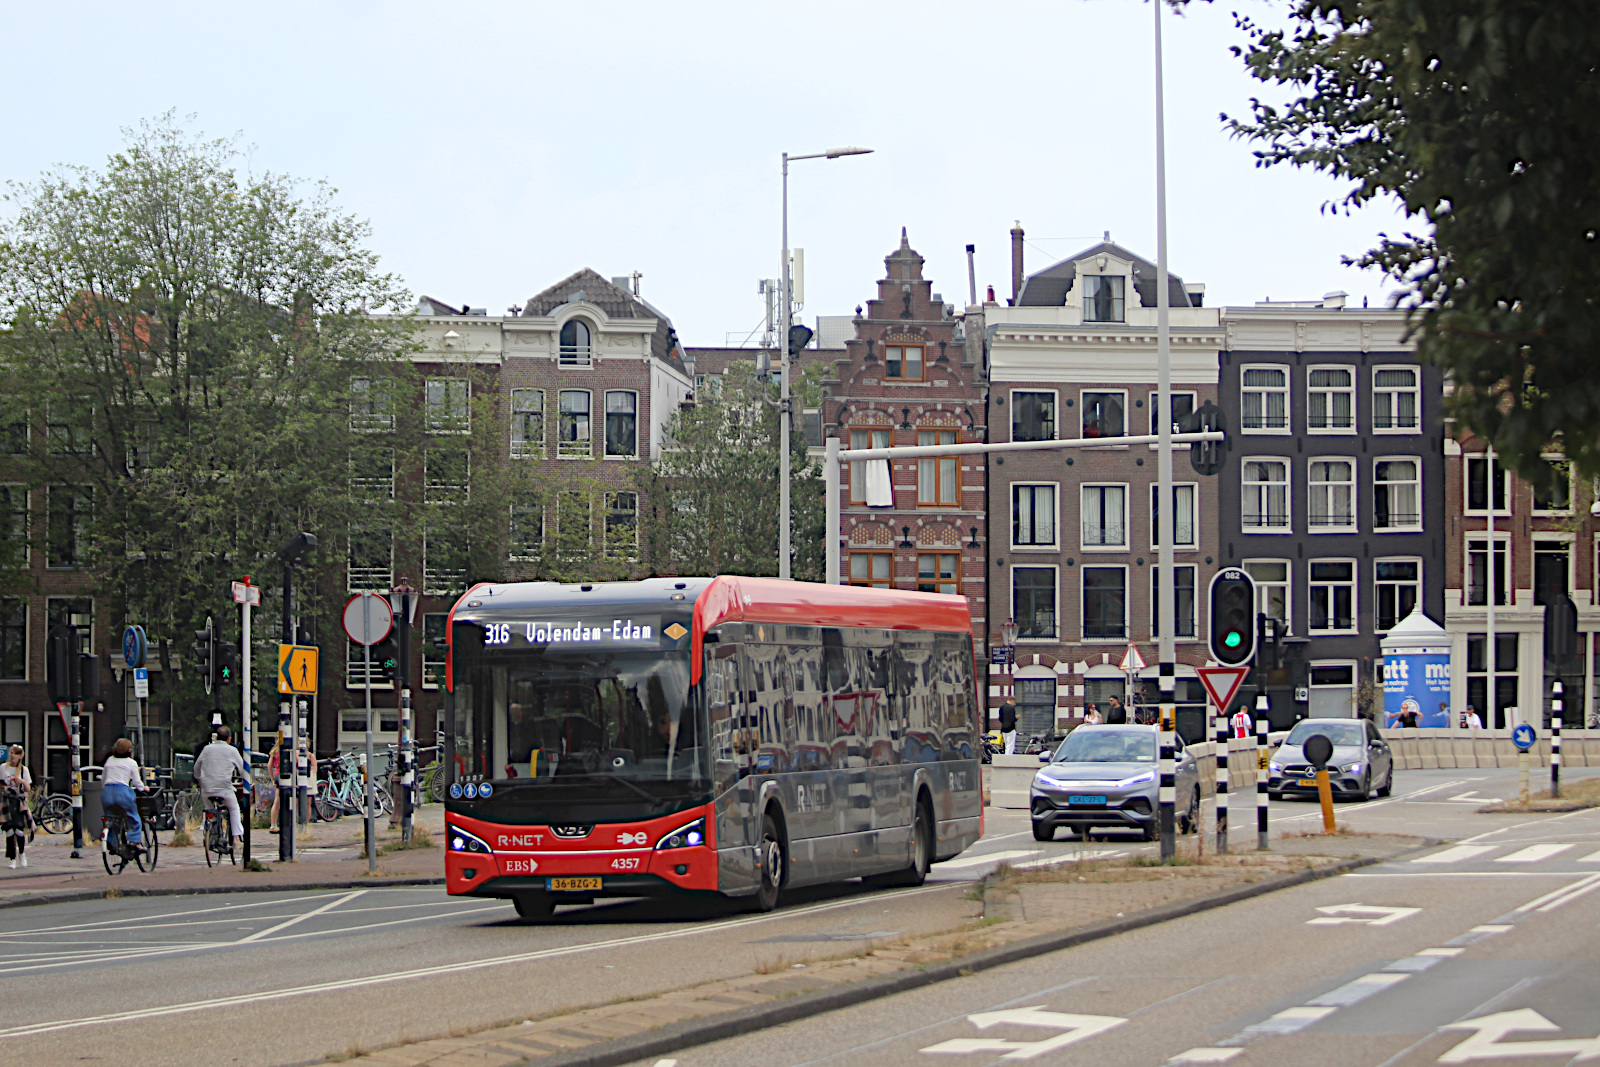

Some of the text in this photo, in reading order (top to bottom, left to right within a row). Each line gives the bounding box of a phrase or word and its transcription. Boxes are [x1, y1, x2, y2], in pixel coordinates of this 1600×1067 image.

[485, 620, 651, 643] 316 Volendam-Edam
[557, 826, 586, 835] VDL
[506, 860, 529, 872] EBS
[611, 858, 640, 869] 4357
[555, 879, 598, 888] 36-BZG-2
